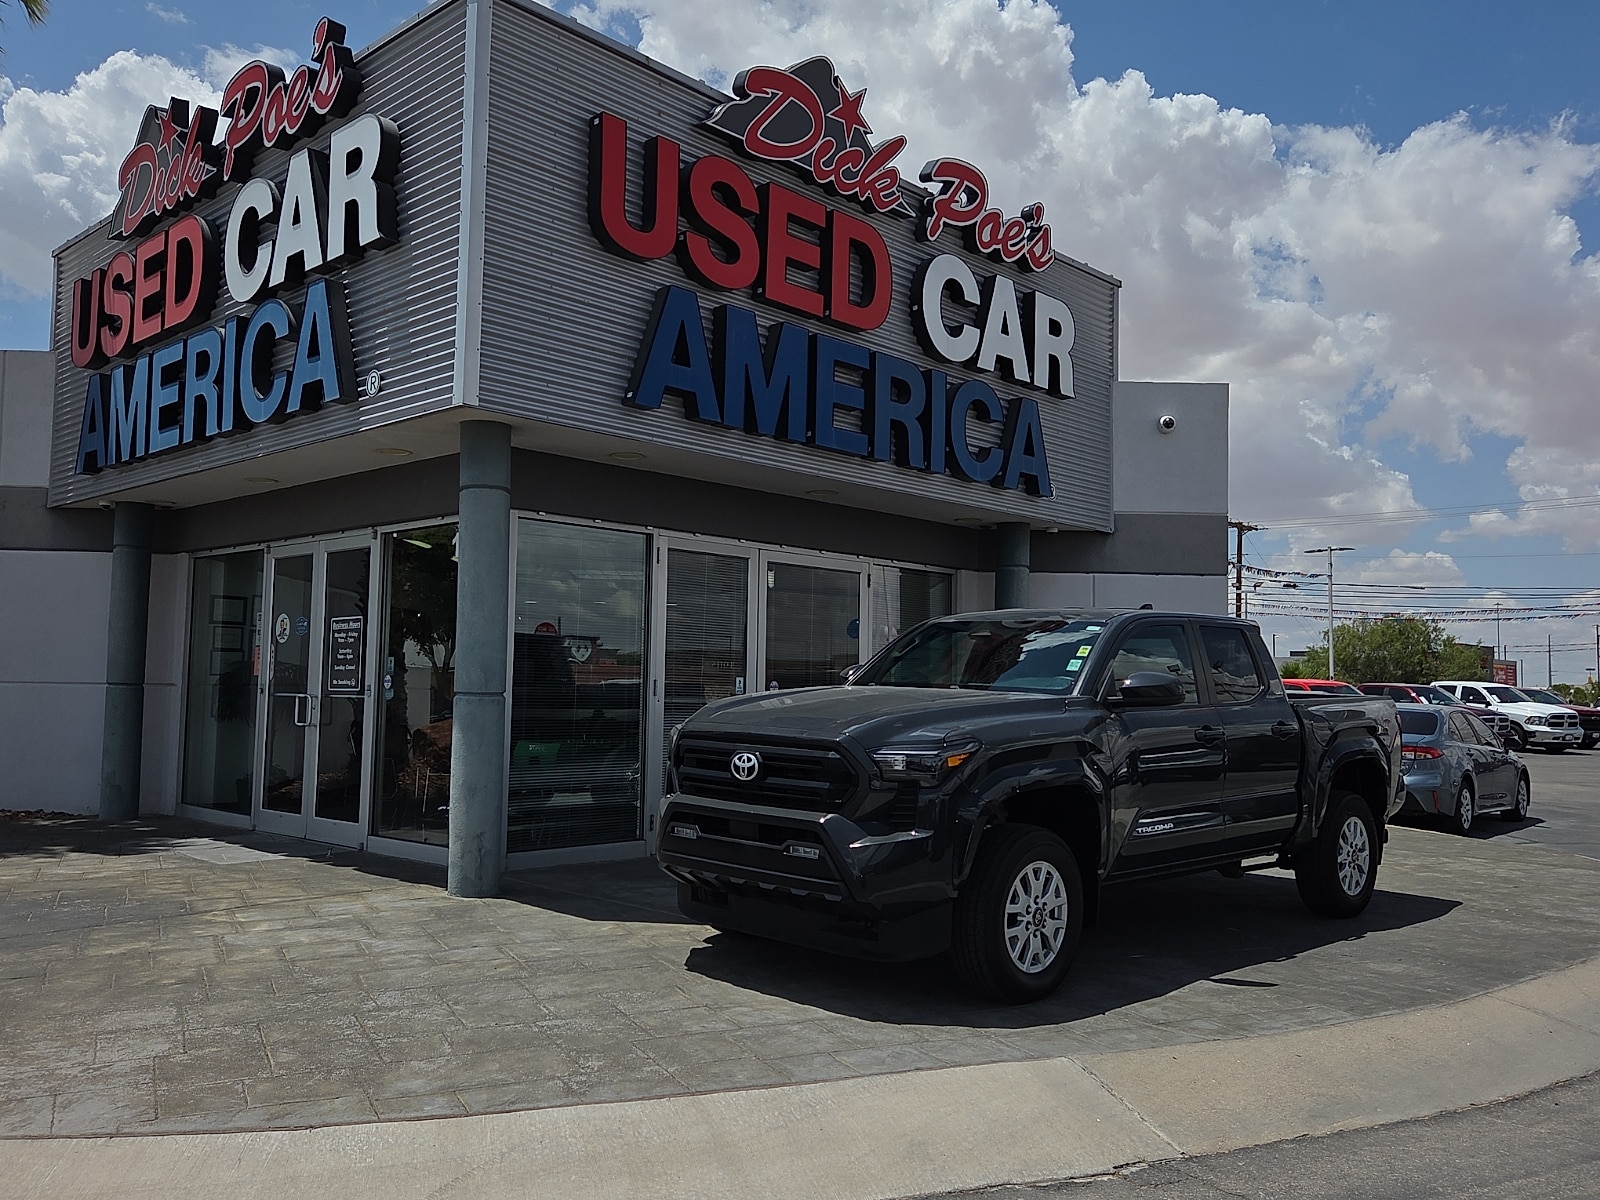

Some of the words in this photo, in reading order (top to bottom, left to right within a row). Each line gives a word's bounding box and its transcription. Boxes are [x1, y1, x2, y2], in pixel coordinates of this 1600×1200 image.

[118, 105, 207, 237] Dick
[222, 16, 344, 183] Poe's
[742, 64, 909, 212] Dick
[924, 156, 1056, 272] Poe's
[70, 214, 204, 370] USED
[224, 113, 383, 303] CAR
[600, 111, 894, 331] USED
[922, 253, 1077, 399] CAR
[75, 277, 342, 476] AMERICA
[632, 284, 1054, 498] AMERICA
[1135, 822, 1174, 834] TACOMA
